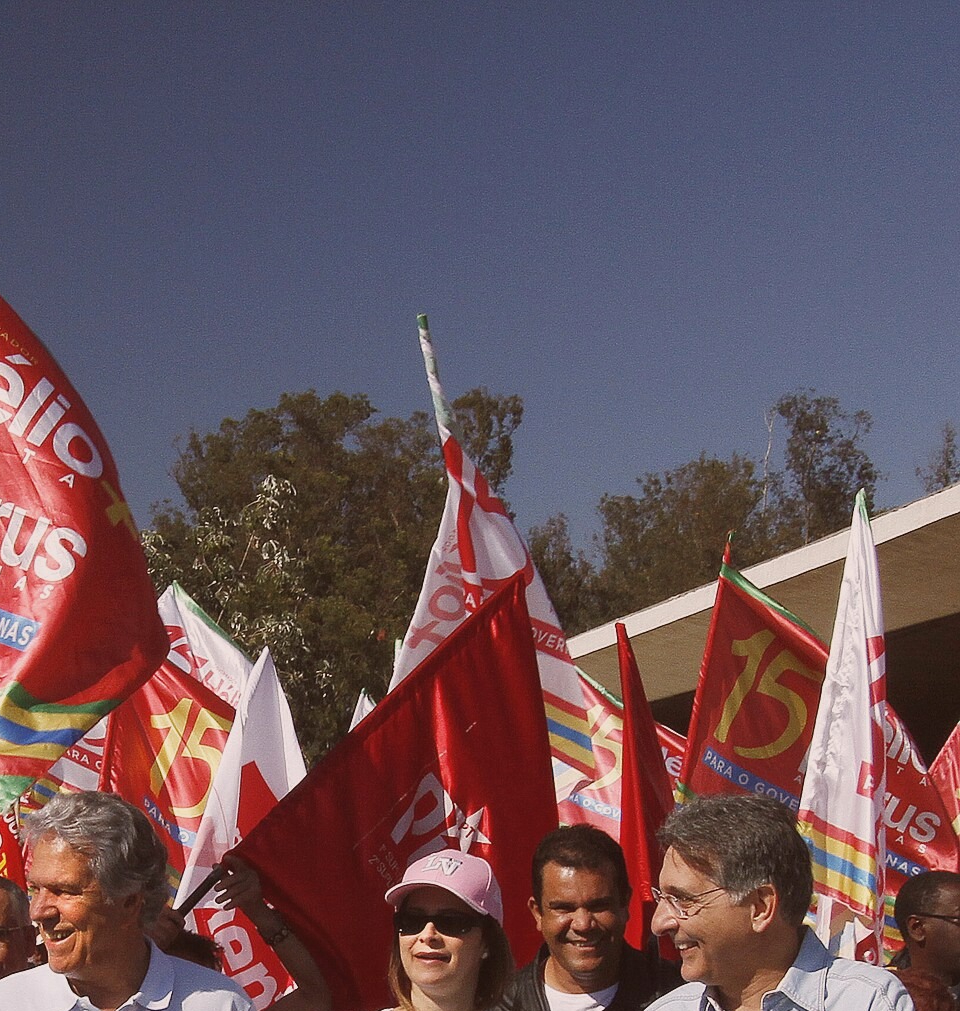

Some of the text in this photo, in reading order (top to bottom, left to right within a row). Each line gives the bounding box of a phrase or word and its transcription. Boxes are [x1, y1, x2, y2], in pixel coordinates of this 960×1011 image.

[714, 629, 824, 759] 15
[150, 698, 235, 818] 15
[704, 748, 733, 778] PARA
[739, 773, 749, 785] O
